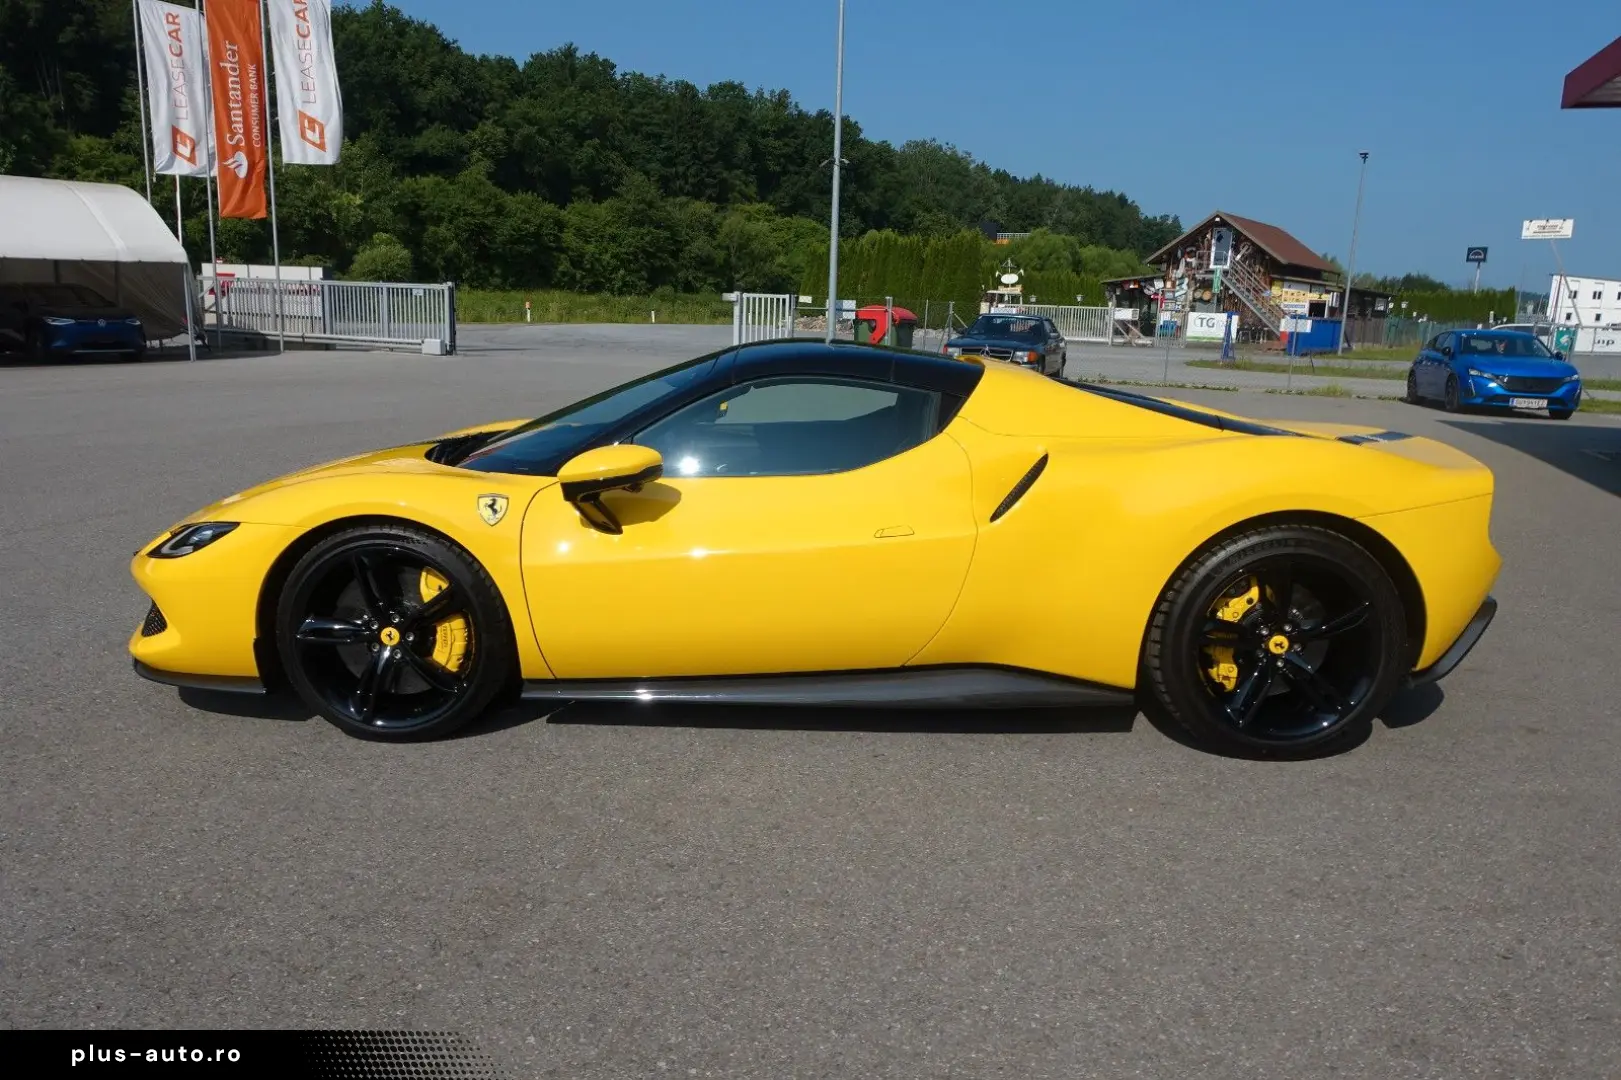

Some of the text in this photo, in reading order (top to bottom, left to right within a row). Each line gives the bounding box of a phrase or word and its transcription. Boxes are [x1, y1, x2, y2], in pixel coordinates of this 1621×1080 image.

[165, 11, 189, 120] LEASECAR
[219, 40, 245, 147] Santander
[248, 63, 261, 148] CONSUMER BANK
